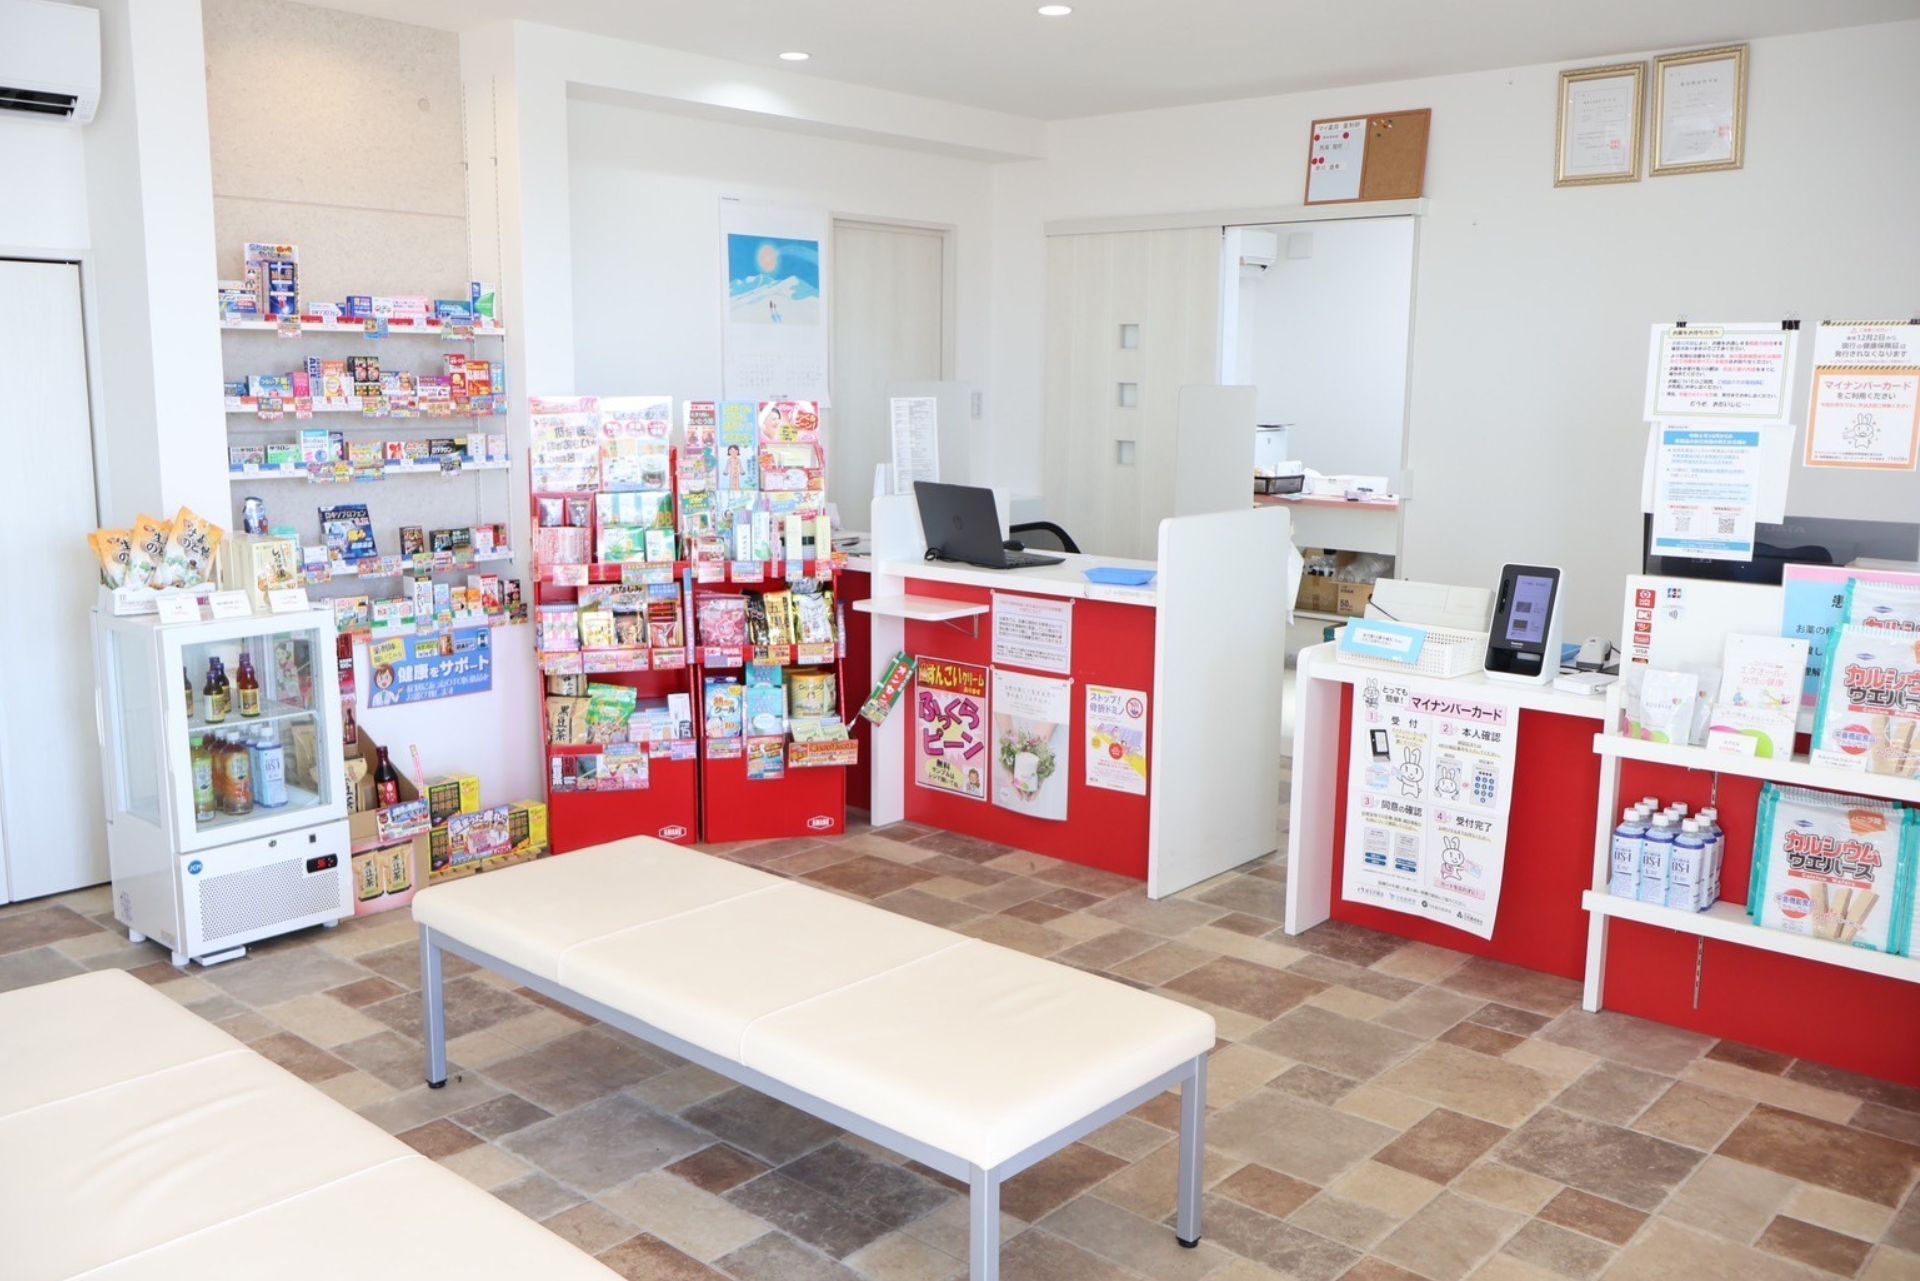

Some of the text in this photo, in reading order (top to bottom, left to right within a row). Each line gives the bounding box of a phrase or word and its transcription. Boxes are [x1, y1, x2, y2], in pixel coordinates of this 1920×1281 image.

[1825, 381, 1912, 391] マイナンバーカード
[398, 655, 489, 683] 健康をサポート
[1383, 686, 1408, 696] とっても
[919, 691, 980, 730] ふっくら
[1412, 697, 1502, 721] マイナンバーカード
[923, 727, 985, 760] ピーン
[1462, 728, 1501, 742] 本人確認
[1381, 800, 1423, 817] 同意の確認
[1456, 816, 1492, 832] 受付完了
[1784, 831, 1881, 867] カルシウム
[1786, 852, 1875, 882] ウエハース
